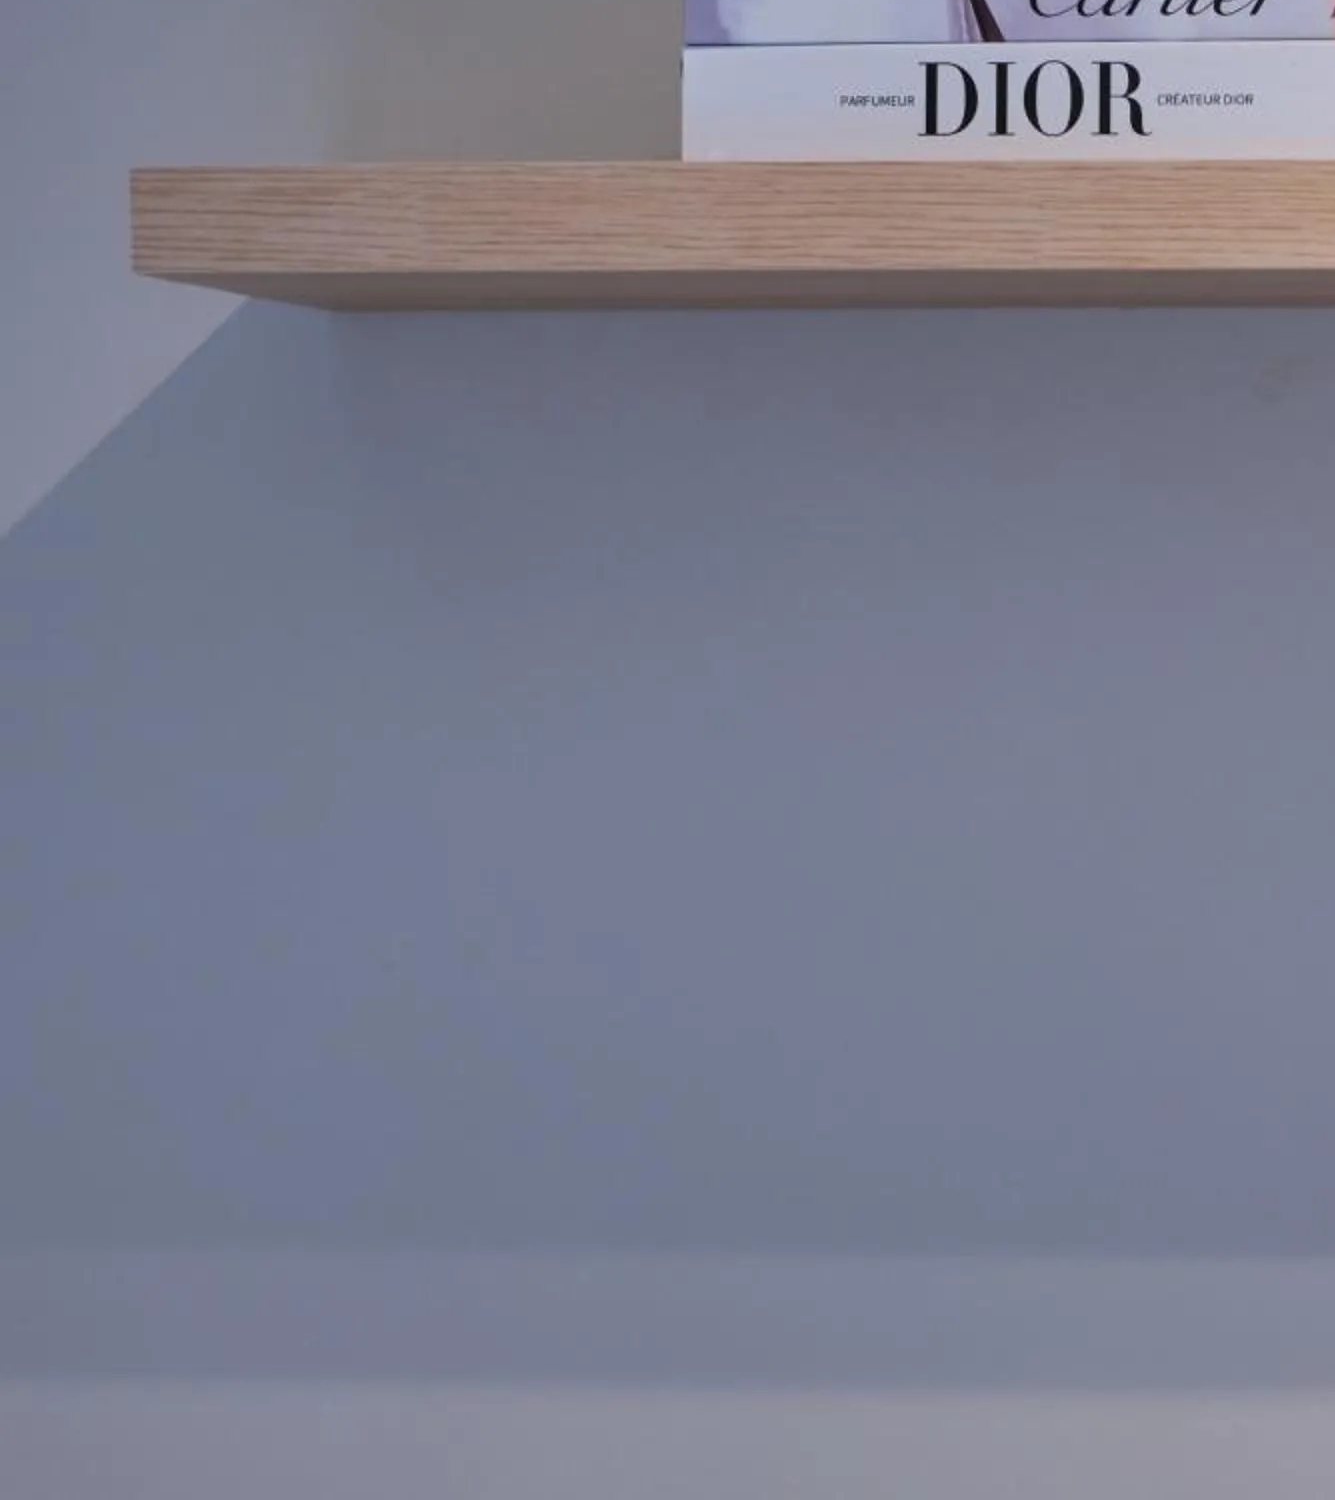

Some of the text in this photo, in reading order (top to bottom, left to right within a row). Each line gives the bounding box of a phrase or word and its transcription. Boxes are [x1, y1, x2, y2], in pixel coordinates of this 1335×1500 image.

[840, 96, 915, 107] PARFUMEUR
[918, 60, 1152, 137] DIOR
[1223, 93, 1254, 106] DIOR
